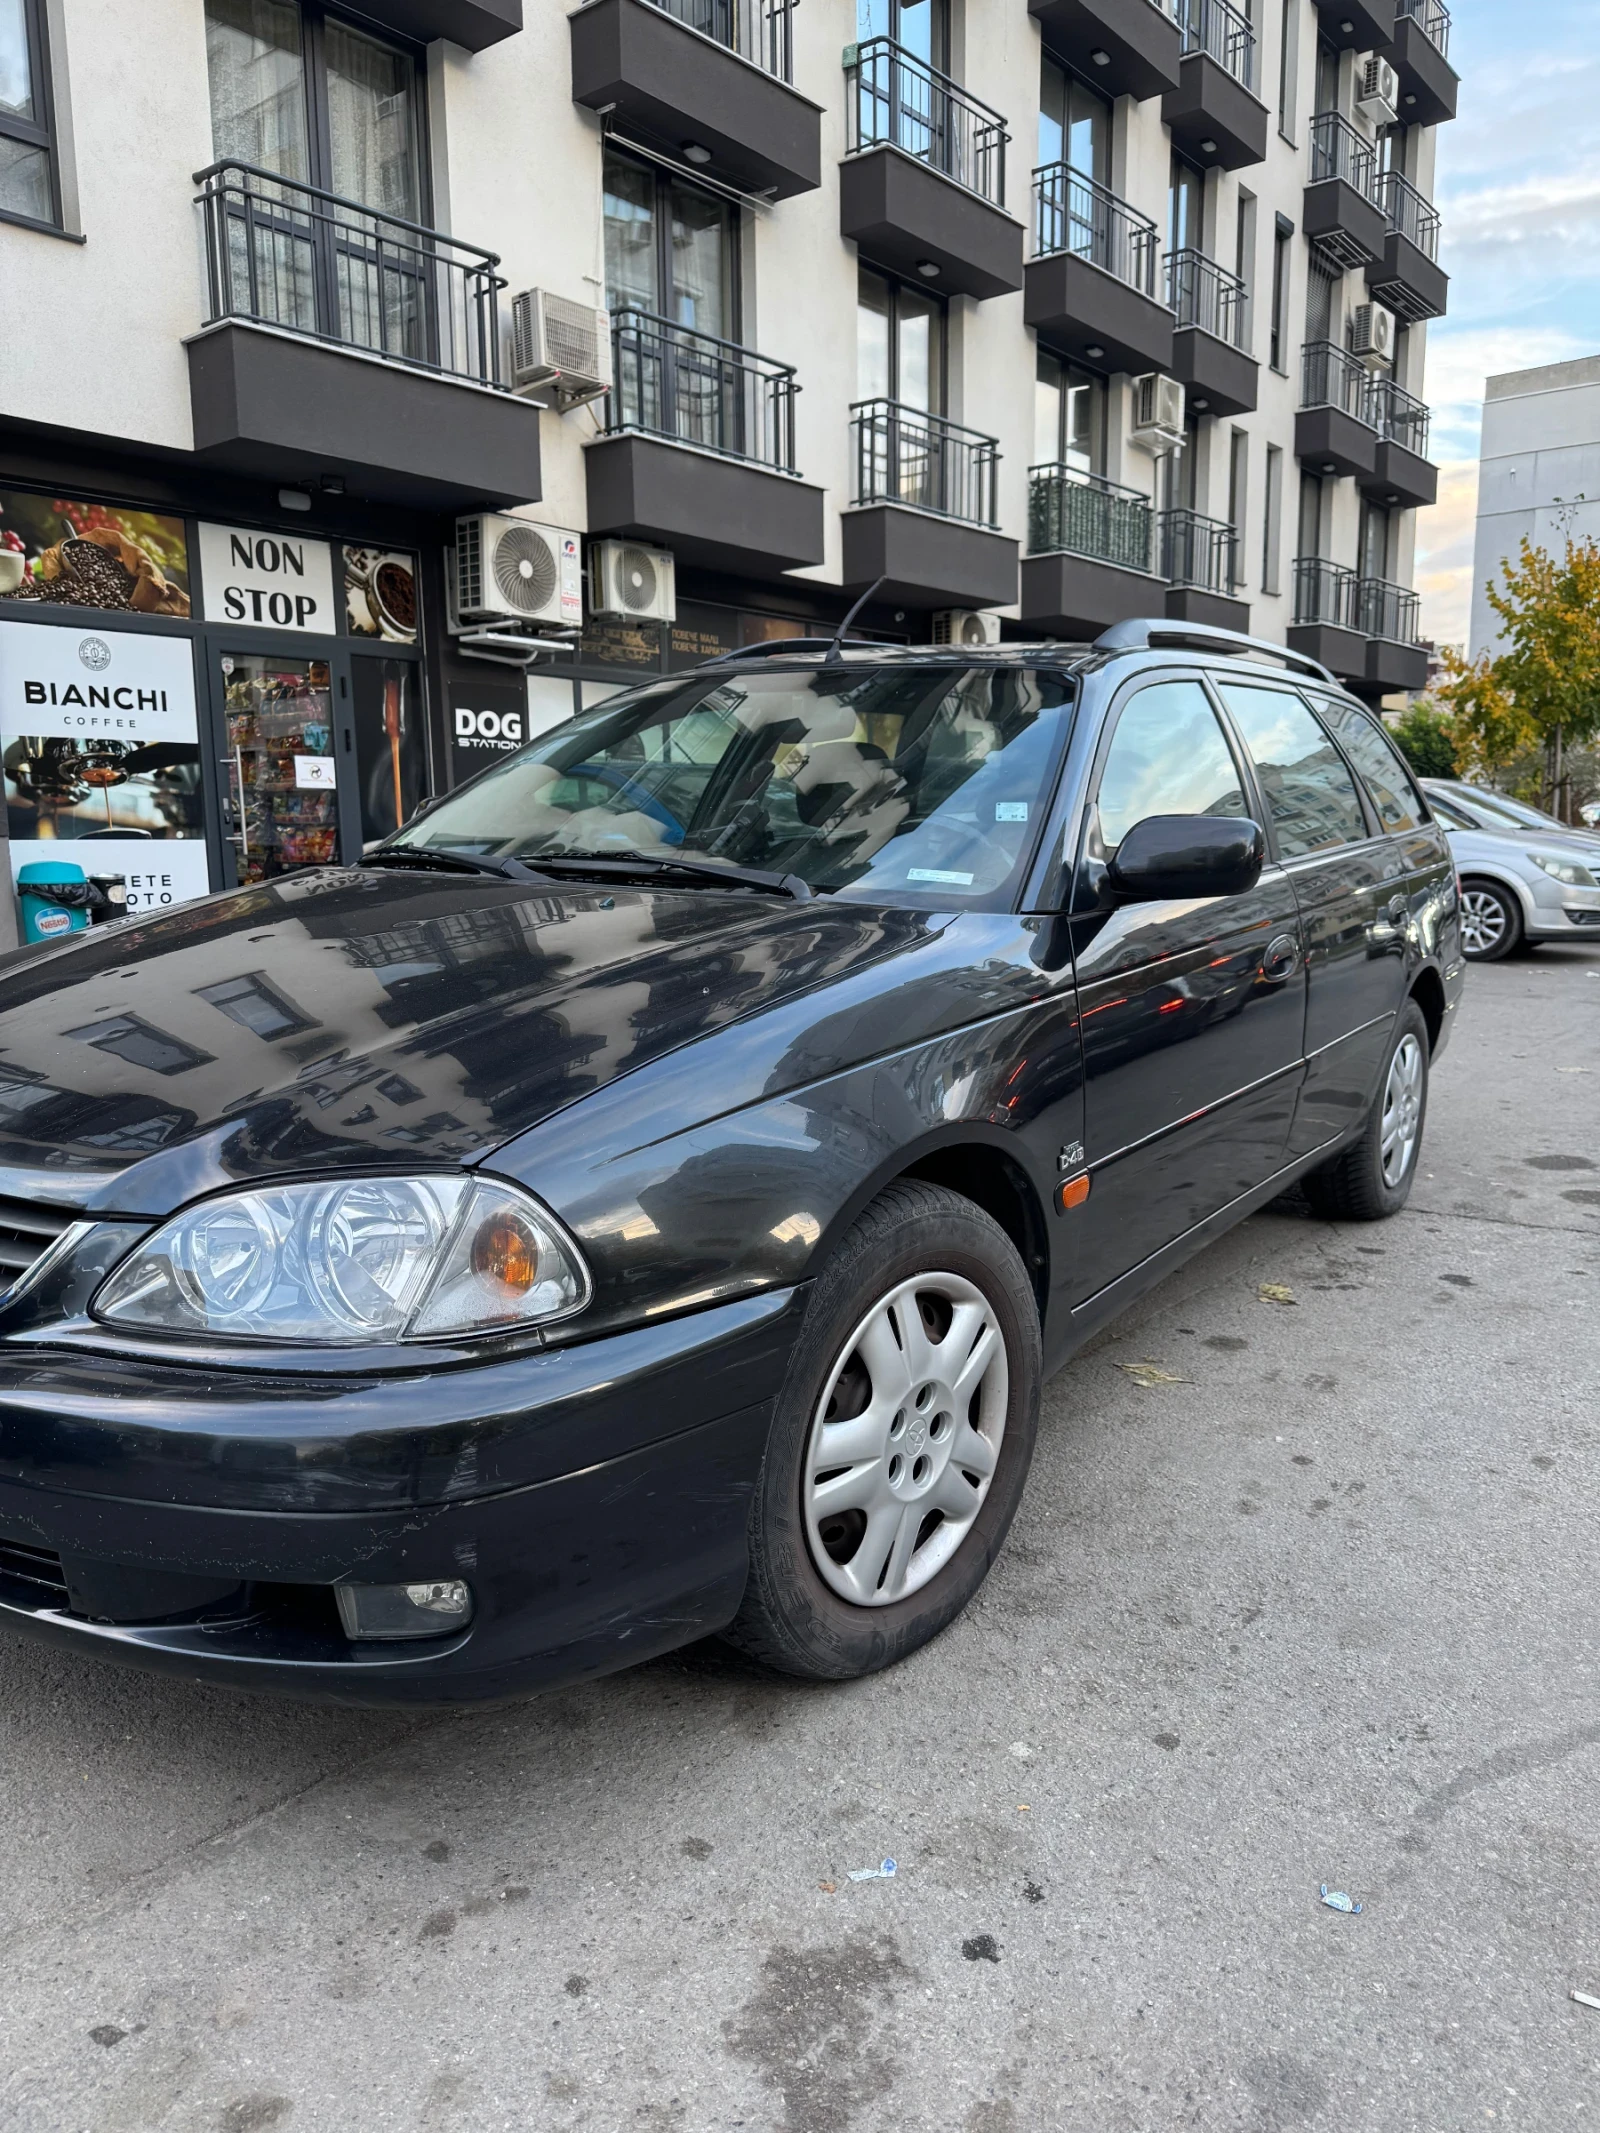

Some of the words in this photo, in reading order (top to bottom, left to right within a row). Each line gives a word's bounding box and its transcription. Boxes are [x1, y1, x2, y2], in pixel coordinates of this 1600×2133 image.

[230, 533, 304, 577] NON
[224, 586, 317, 628] STOP
[24, 681, 168, 712] BIANCHI
[63, 716, 136, 728] COFFEE
[455, 708, 522, 740] DOG
[458, 737, 522, 750] STATION
